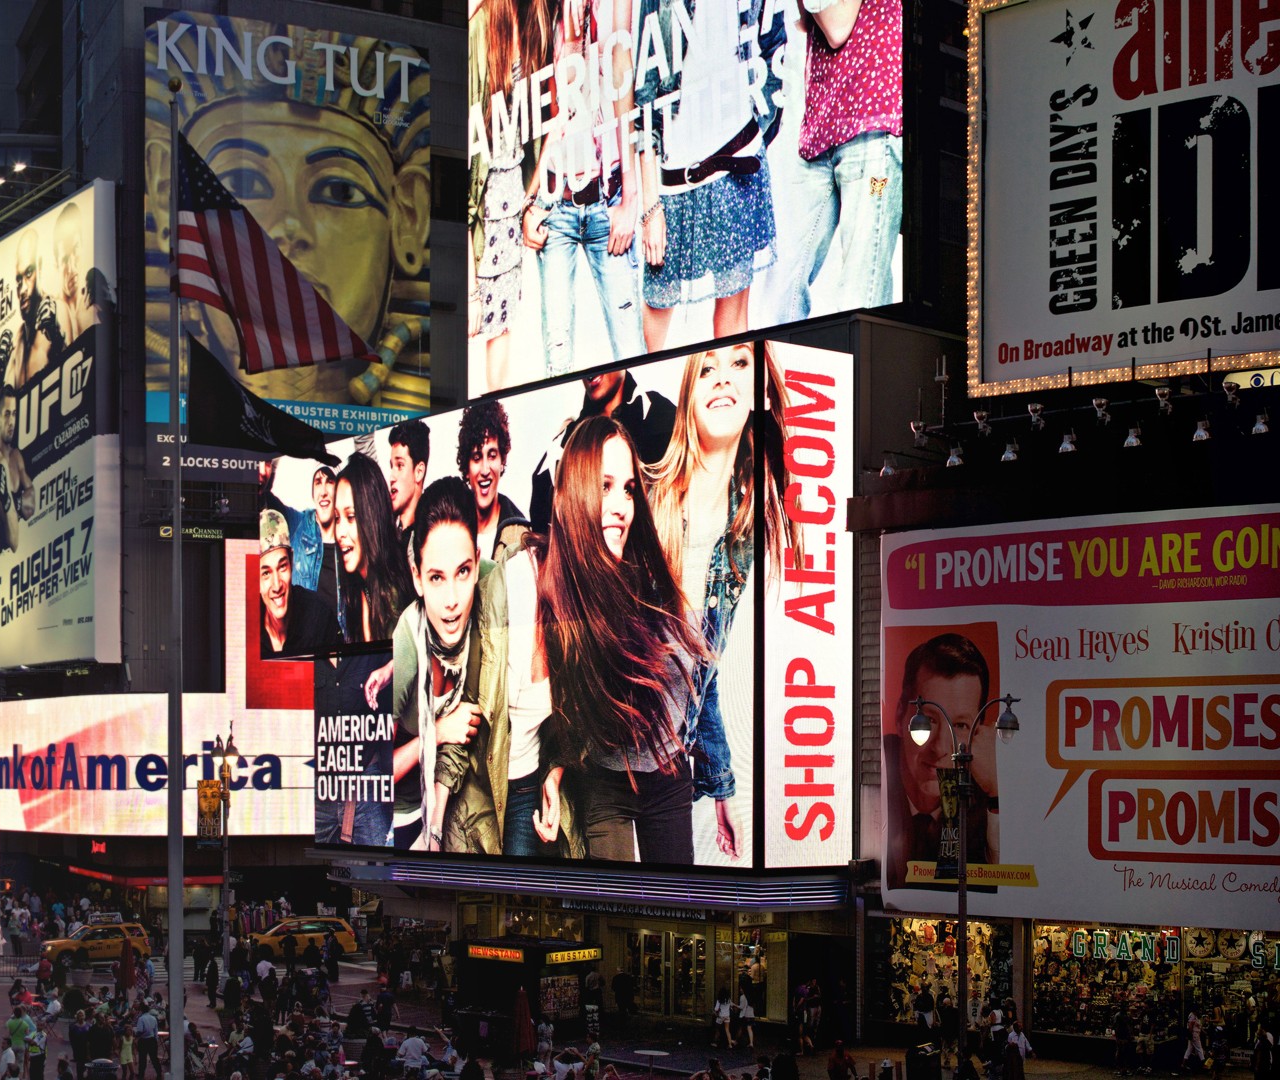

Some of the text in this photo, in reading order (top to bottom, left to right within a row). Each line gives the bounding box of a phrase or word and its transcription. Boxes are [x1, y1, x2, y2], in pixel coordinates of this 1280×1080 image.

[157, 20, 421, 103] KING TUT
[468, 0, 694, 170] AMERICAN
[1049, 84, 1098, 315] GREEN DAY'S
[998, 313, 1227, 365] On Broadway at the St.
[71, 356, 93, 396] 117
[17, 350, 84, 450] UFC
[342, 409, 409, 424] EXHIBITION
[340, 420, 353, 431] TO
[162, 456, 266, 471] 2 LOCKS SOUTH
[40, 467, 71, 510] FITCH
[56, 476, 94, 521] ALVES
[10, 527, 75, 599] AUGUST
[80, 516, 94, 555] 7
[904, 531, 1201, 590] "I PROMISE YOU ARE
[1, 602, 13, 627] ON
[16, 553, 93, 617] PAY-PER-VIEW
[1159, 577, 1177, 590] DAVID
[1229, 574, 1247, 586] RADIO
[785, 368, 836, 842] SHOP AE.COM
[1015, 621, 1257, 663] Sean Hayes Kristin
[317, 713, 394, 743] AMERICAN
[1064, 693, 1280, 752] PROMISES
[31, 742, 55, 790] of
[60, 741, 281, 791] America
[317, 744, 364, 773] EAGLE
[317, 773, 394, 803] OUTFITTE
[198, 817, 220, 827] KING
[1107, 787, 1280, 848] PROMIS
[1113, 863, 1144, 892] The
[1148, 871, 1217, 891] Musical
[471, 946, 522, 960] NEWSSTAND
[548, 950, 599, 963] NEWSSTAND
[1073, 931, 1180, 964] GRAND
